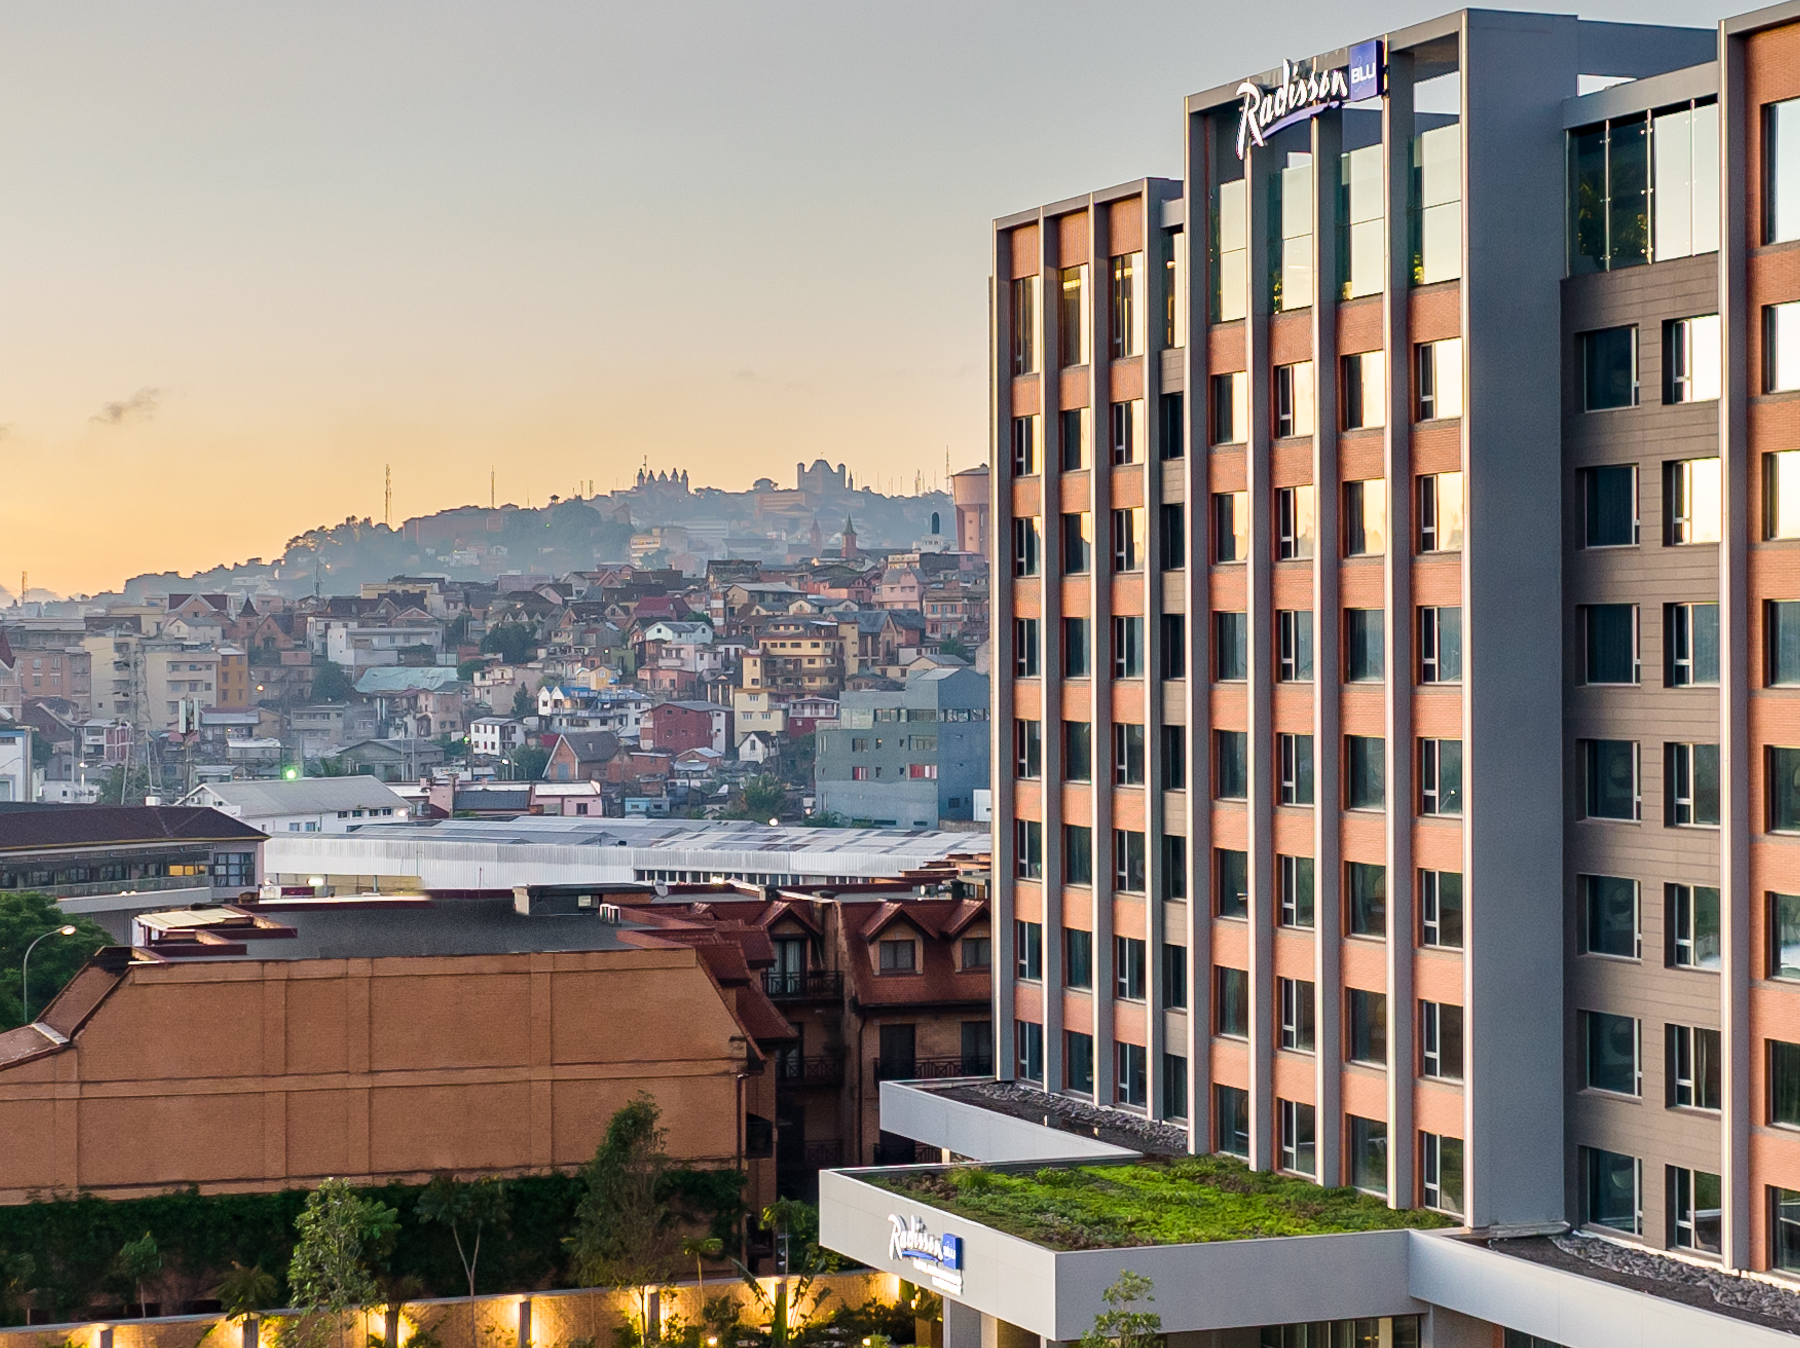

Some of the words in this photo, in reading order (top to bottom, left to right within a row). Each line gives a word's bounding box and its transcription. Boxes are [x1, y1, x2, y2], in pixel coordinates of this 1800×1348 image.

[1236, 58, 1348, 160] Radisson
[1351, 63, 1376, 83] BLU
[888, 1214, 943, 1260] Radisson
